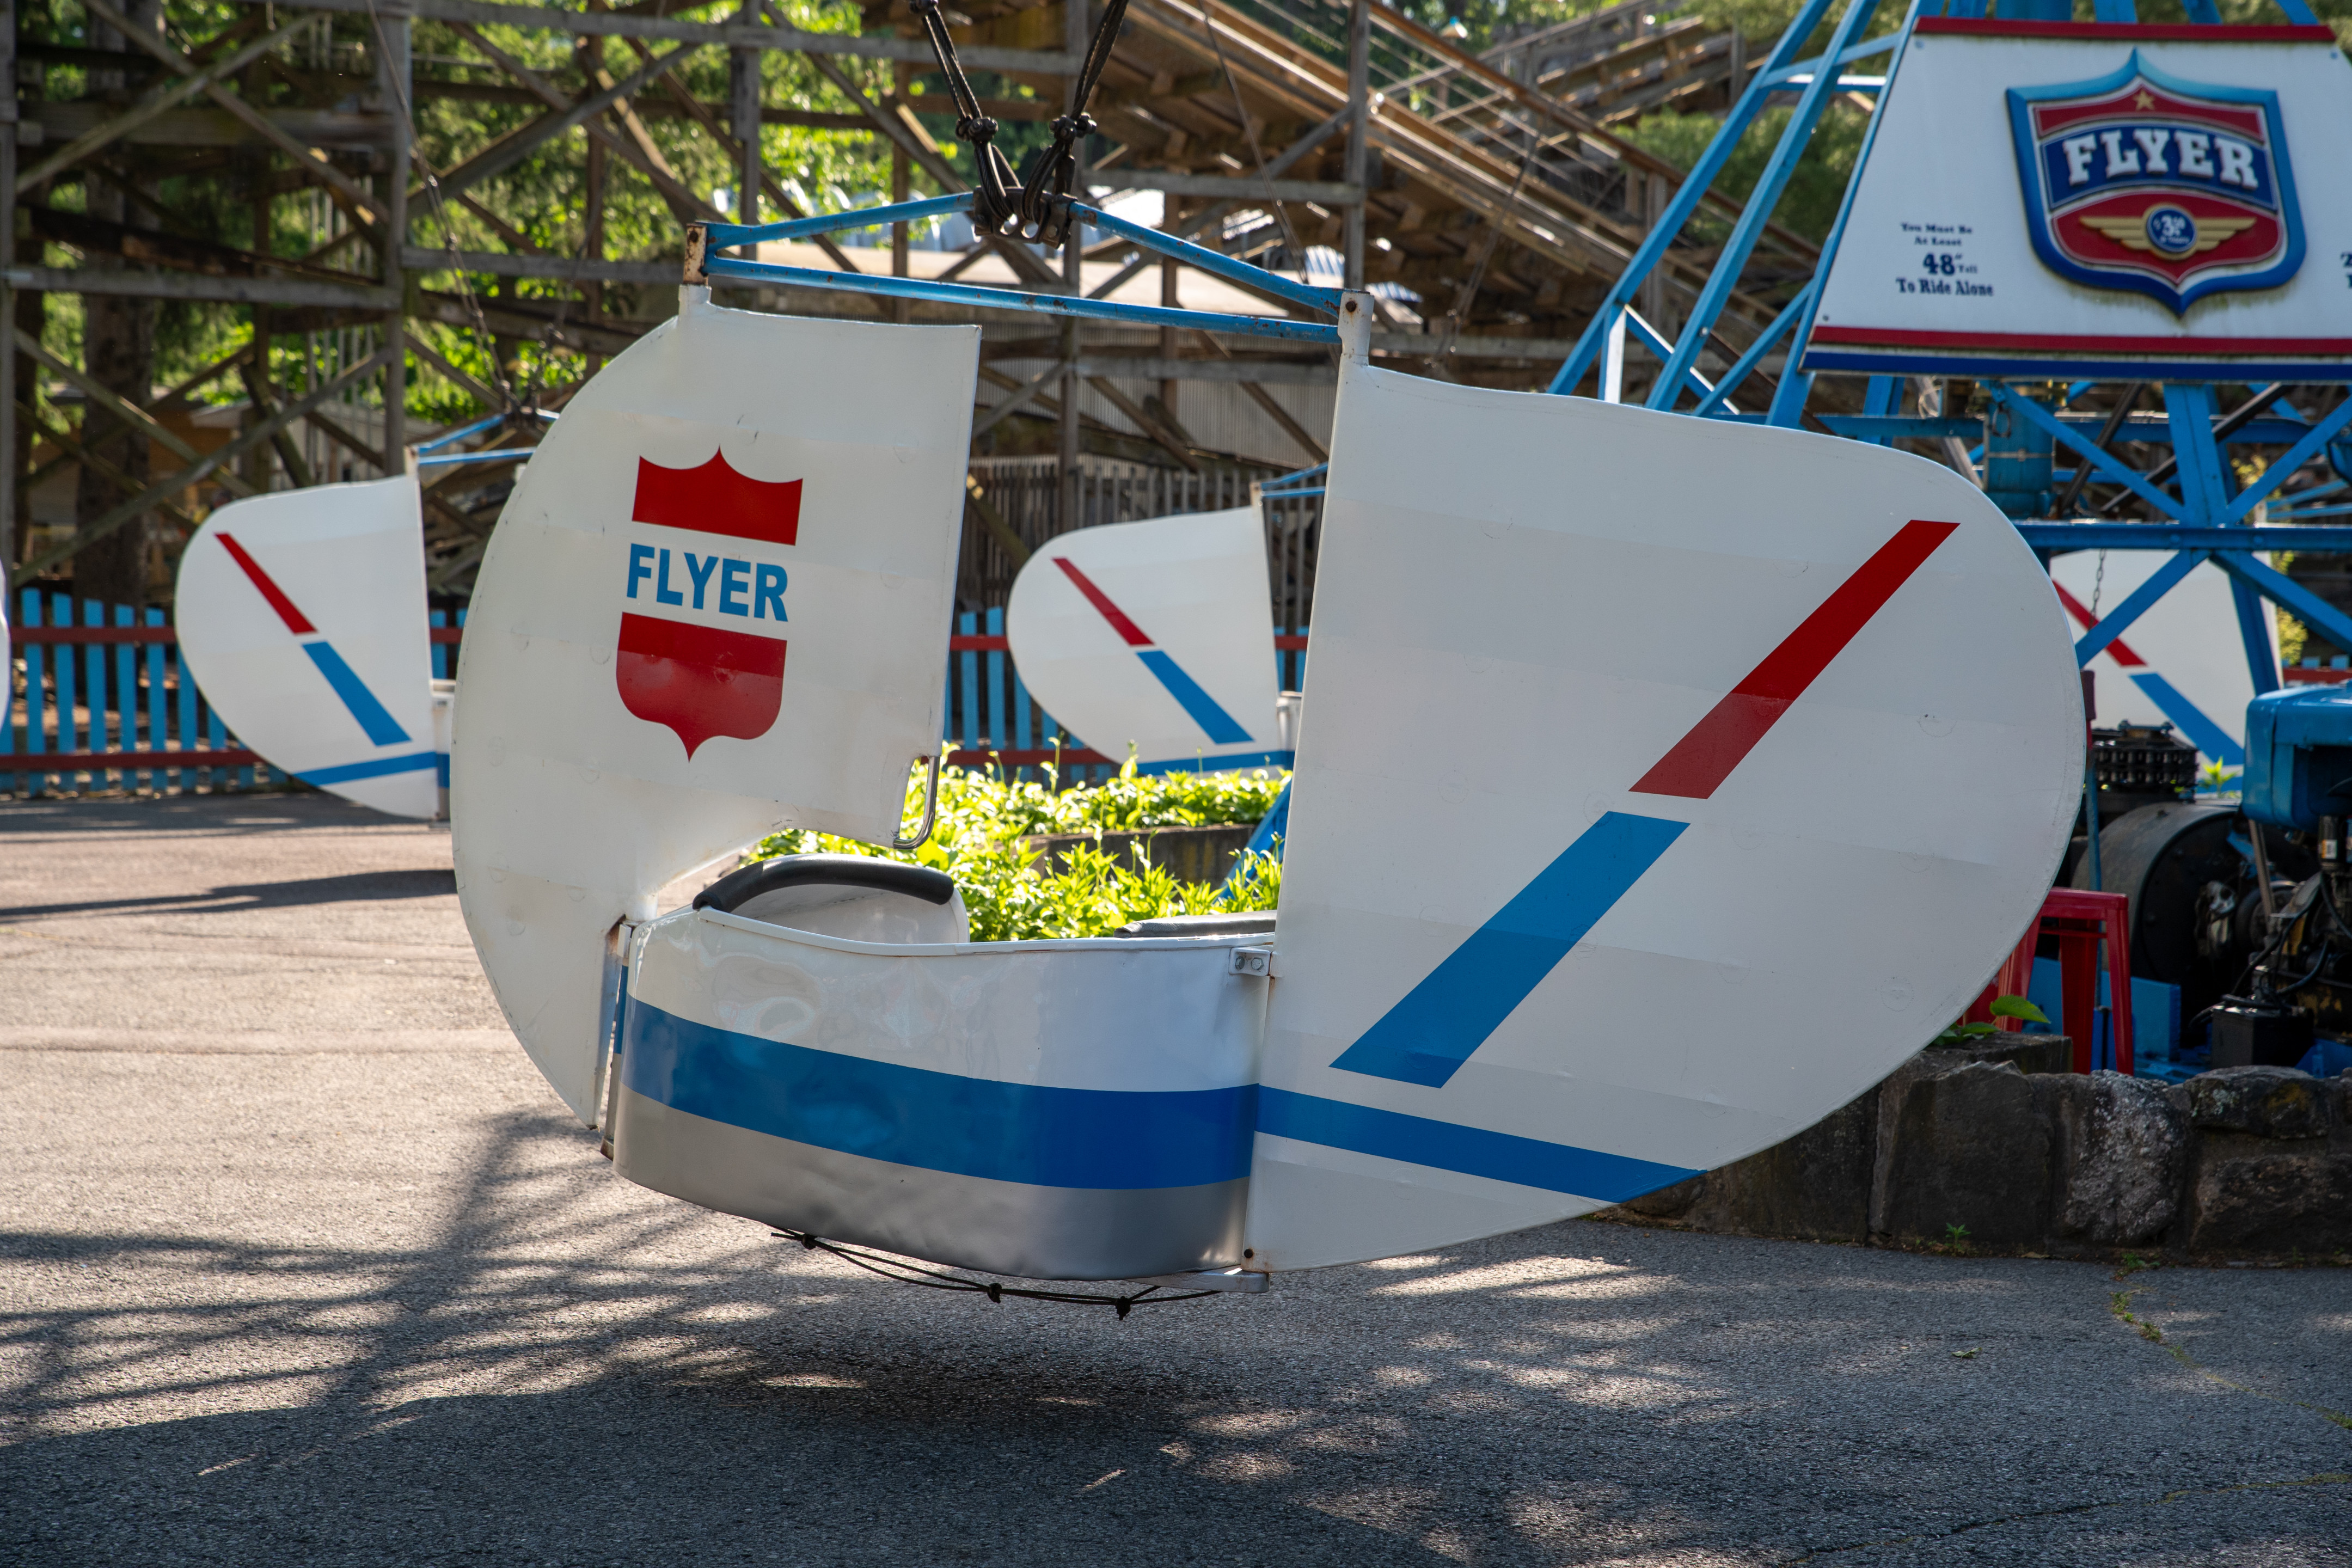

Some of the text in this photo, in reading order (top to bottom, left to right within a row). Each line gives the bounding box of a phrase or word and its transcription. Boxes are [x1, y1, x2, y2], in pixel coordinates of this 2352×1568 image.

[2062, 128, 2259, 191] FLYER
[1901, 222, 1973, 235] You Must Be
[1914, 236, 1962, 246] At Least
[1895, 277, 1994, 297] To Ride Alone
[627, 543, 788, 622] FLYER
